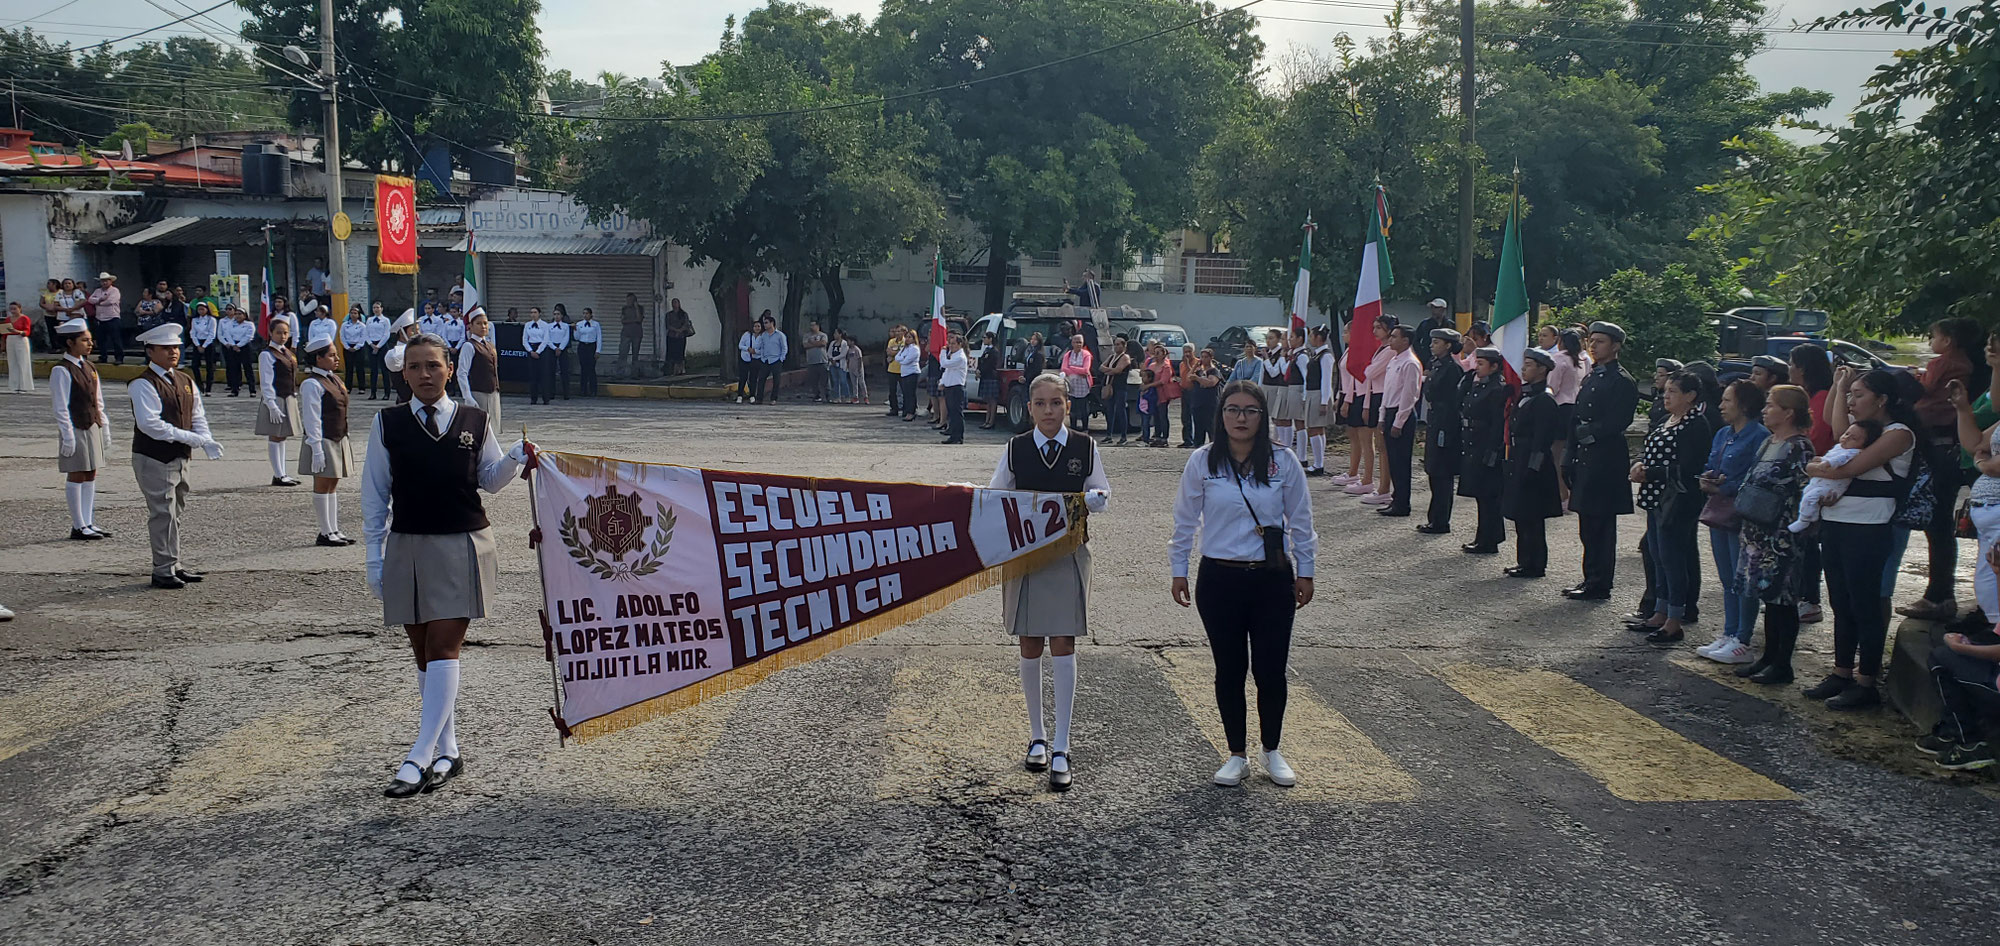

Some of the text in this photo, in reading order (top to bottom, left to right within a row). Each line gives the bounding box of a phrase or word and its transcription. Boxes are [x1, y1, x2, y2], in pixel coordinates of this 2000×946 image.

[472, 211, 559, 230] DEPOSITO
[563, 214, 578, 227] DE
[712, 481, 893, 534] ESCUELA
[1001, 497, 1066, 552] No 2
[723, 521, 957, 600] SECUNDARIA
[557, 592, 700, 625] LIC. ADOLFO
[732, 572, 903, 658] TECNICA
[555, 618, 724, 656] LOPEZ MATEOS
[563, 648, 712, 683] JOJUTLA MOR.
